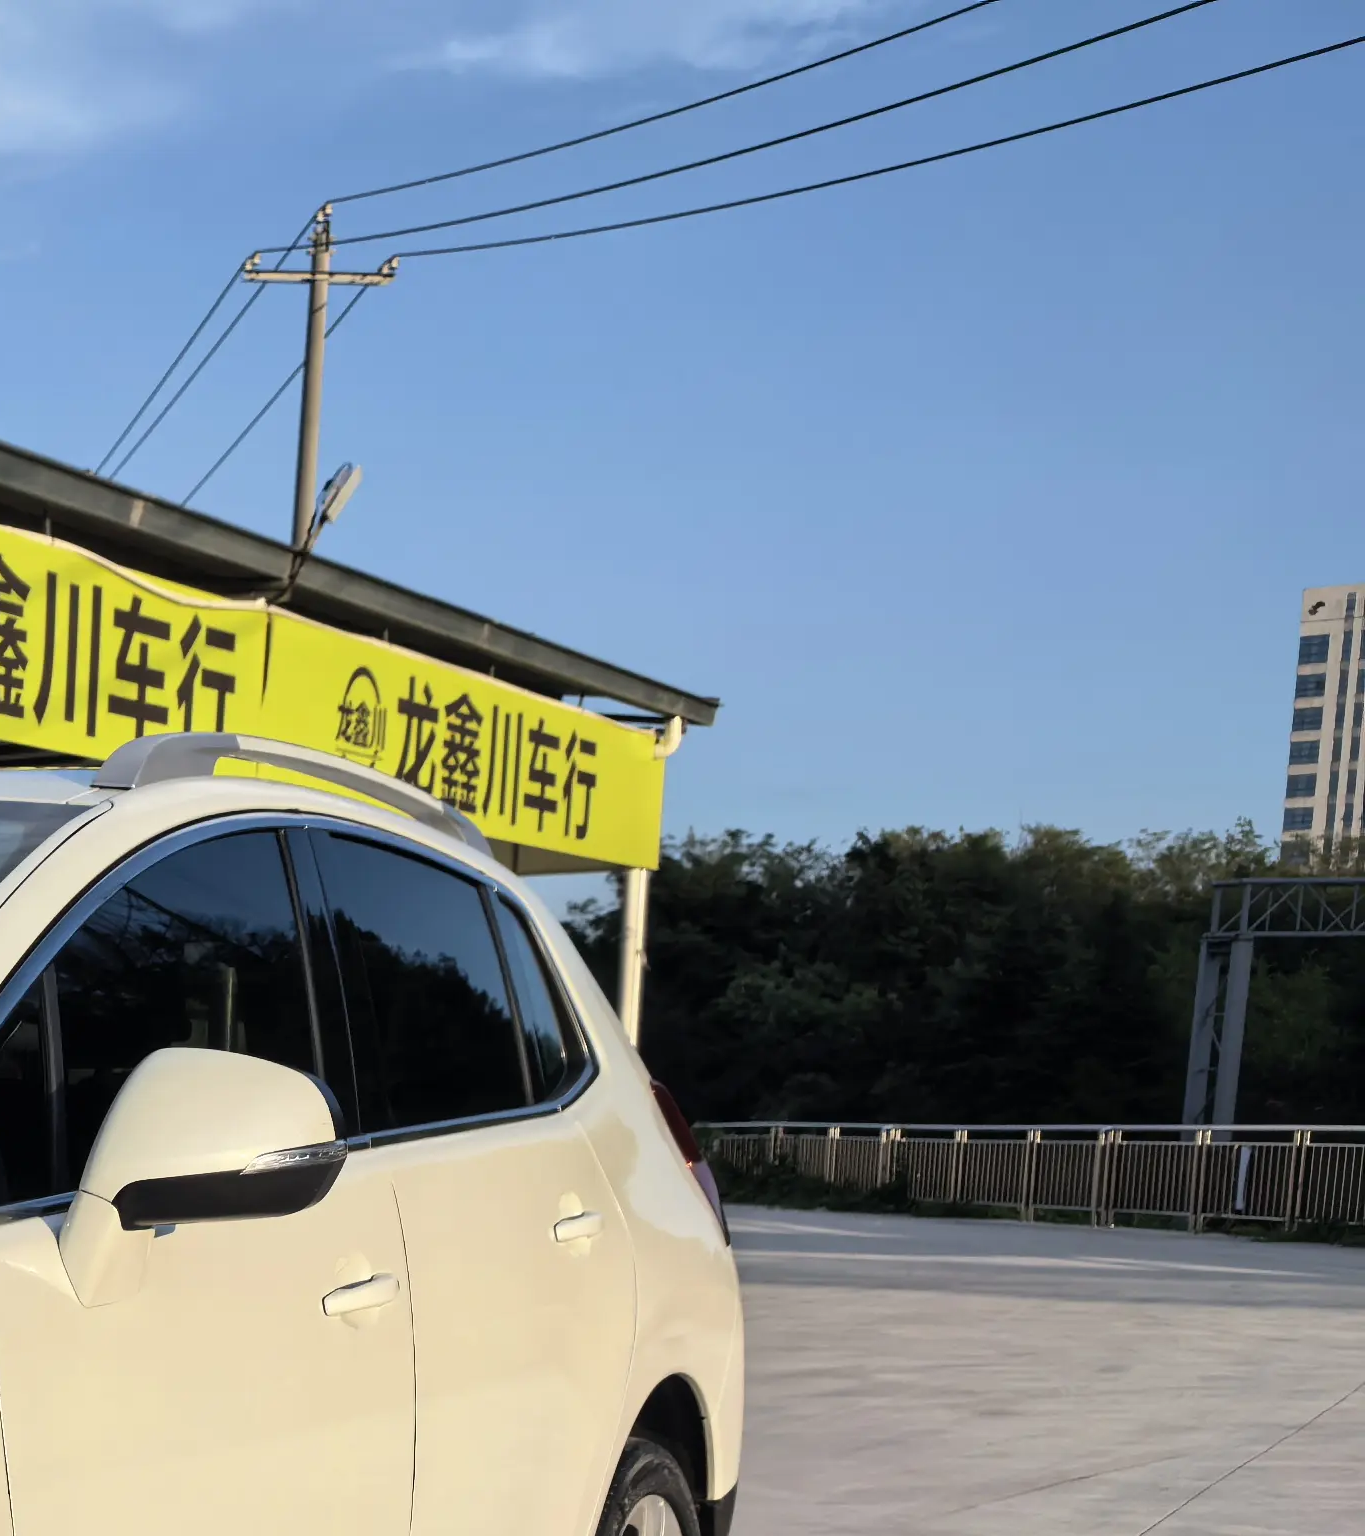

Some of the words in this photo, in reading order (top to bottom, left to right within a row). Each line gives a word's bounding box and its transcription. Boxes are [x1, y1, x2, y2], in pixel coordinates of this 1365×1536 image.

[334, 700, 387, 751] 龙鑫川
[394, 676, 597, 840] 龙鑫川车行
